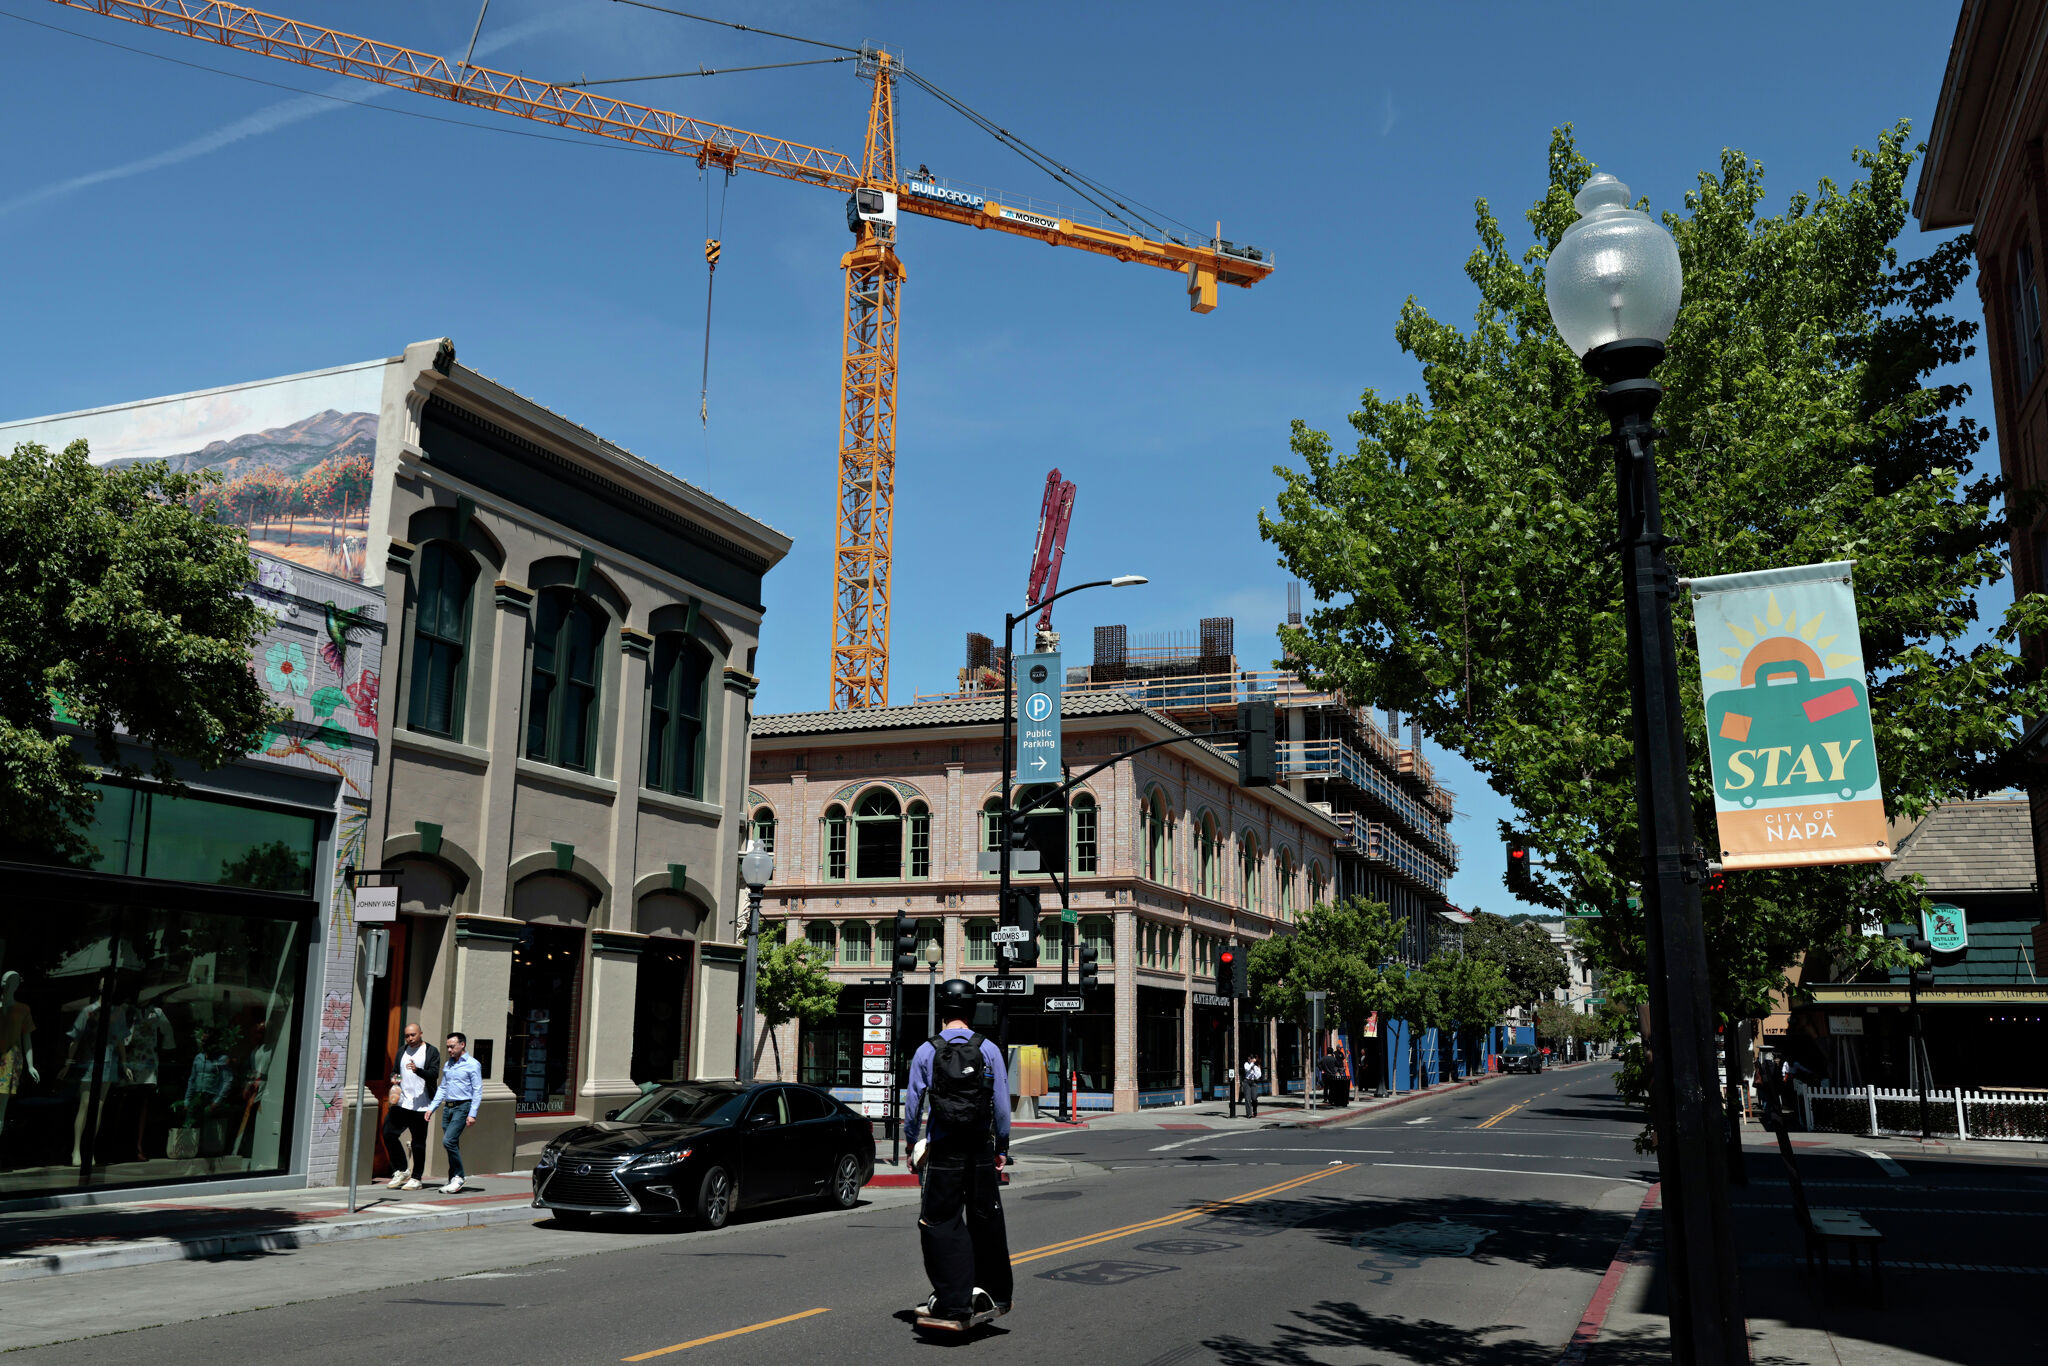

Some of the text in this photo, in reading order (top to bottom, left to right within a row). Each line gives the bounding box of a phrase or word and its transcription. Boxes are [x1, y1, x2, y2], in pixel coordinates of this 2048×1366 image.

[911, 182, 984, 206] BUILDGROUP
[1015, 212, 1056, 228] MORROW
[1034, 699, 1046, 716] P
[1026, 729, 1052, 739] Public
[1023, 740, 1055, 749] Parking
[1725, 739, 1862, 790] STAY
[1765, 809, 1835, 824] CITY OF
[1766, 821, 1837, 843] NAPA
[382, 900, 396, 908] WAS
[993, 931, 1020, 941] COOMBS
[988, 980, 1022, 989] ONE WAY
